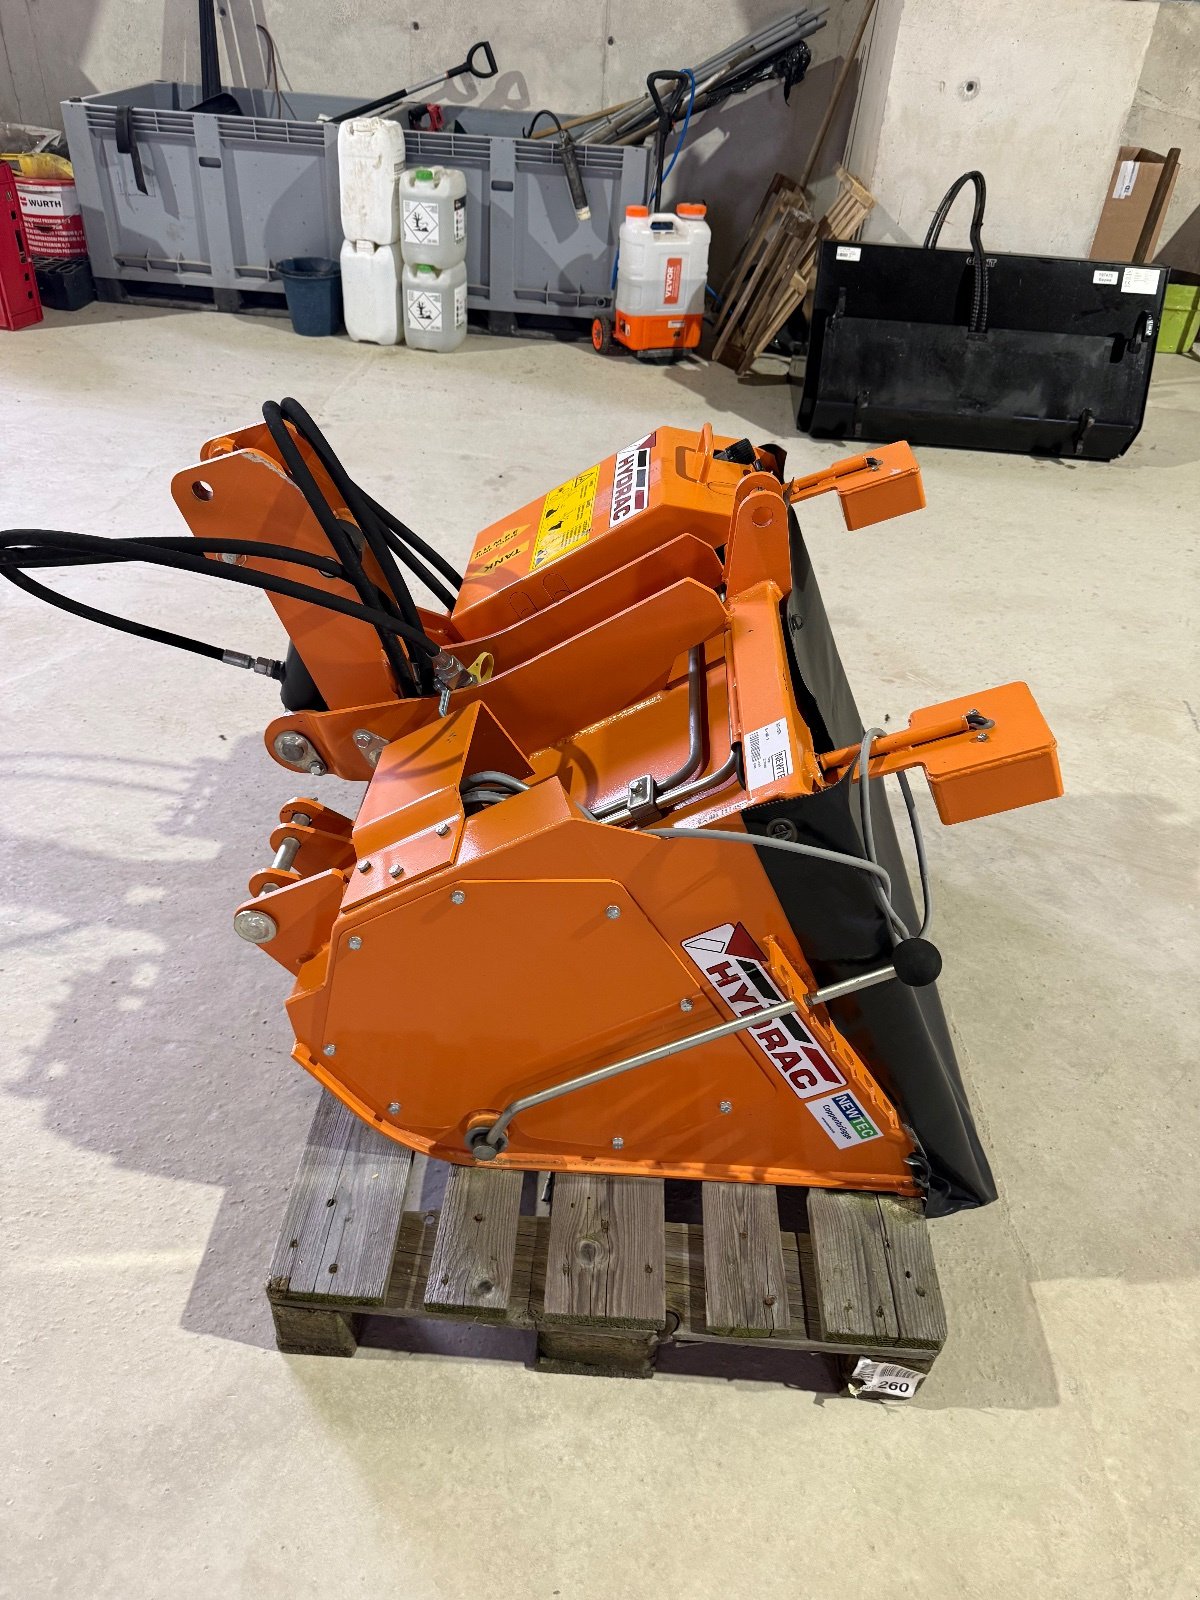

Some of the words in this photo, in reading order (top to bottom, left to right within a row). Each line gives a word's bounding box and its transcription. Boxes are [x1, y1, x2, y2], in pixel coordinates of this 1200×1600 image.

[665, 266, 674, 298] VEVOR
[613, 453, 635, 521] HYDRAC
[484, 549, 521, 573] TANK
[822, 1104, 853, 1140] Coppenbrügge
[835, 1094, 874, 1137] NEWTEC
[877, 1380, 910, 1393] 260
